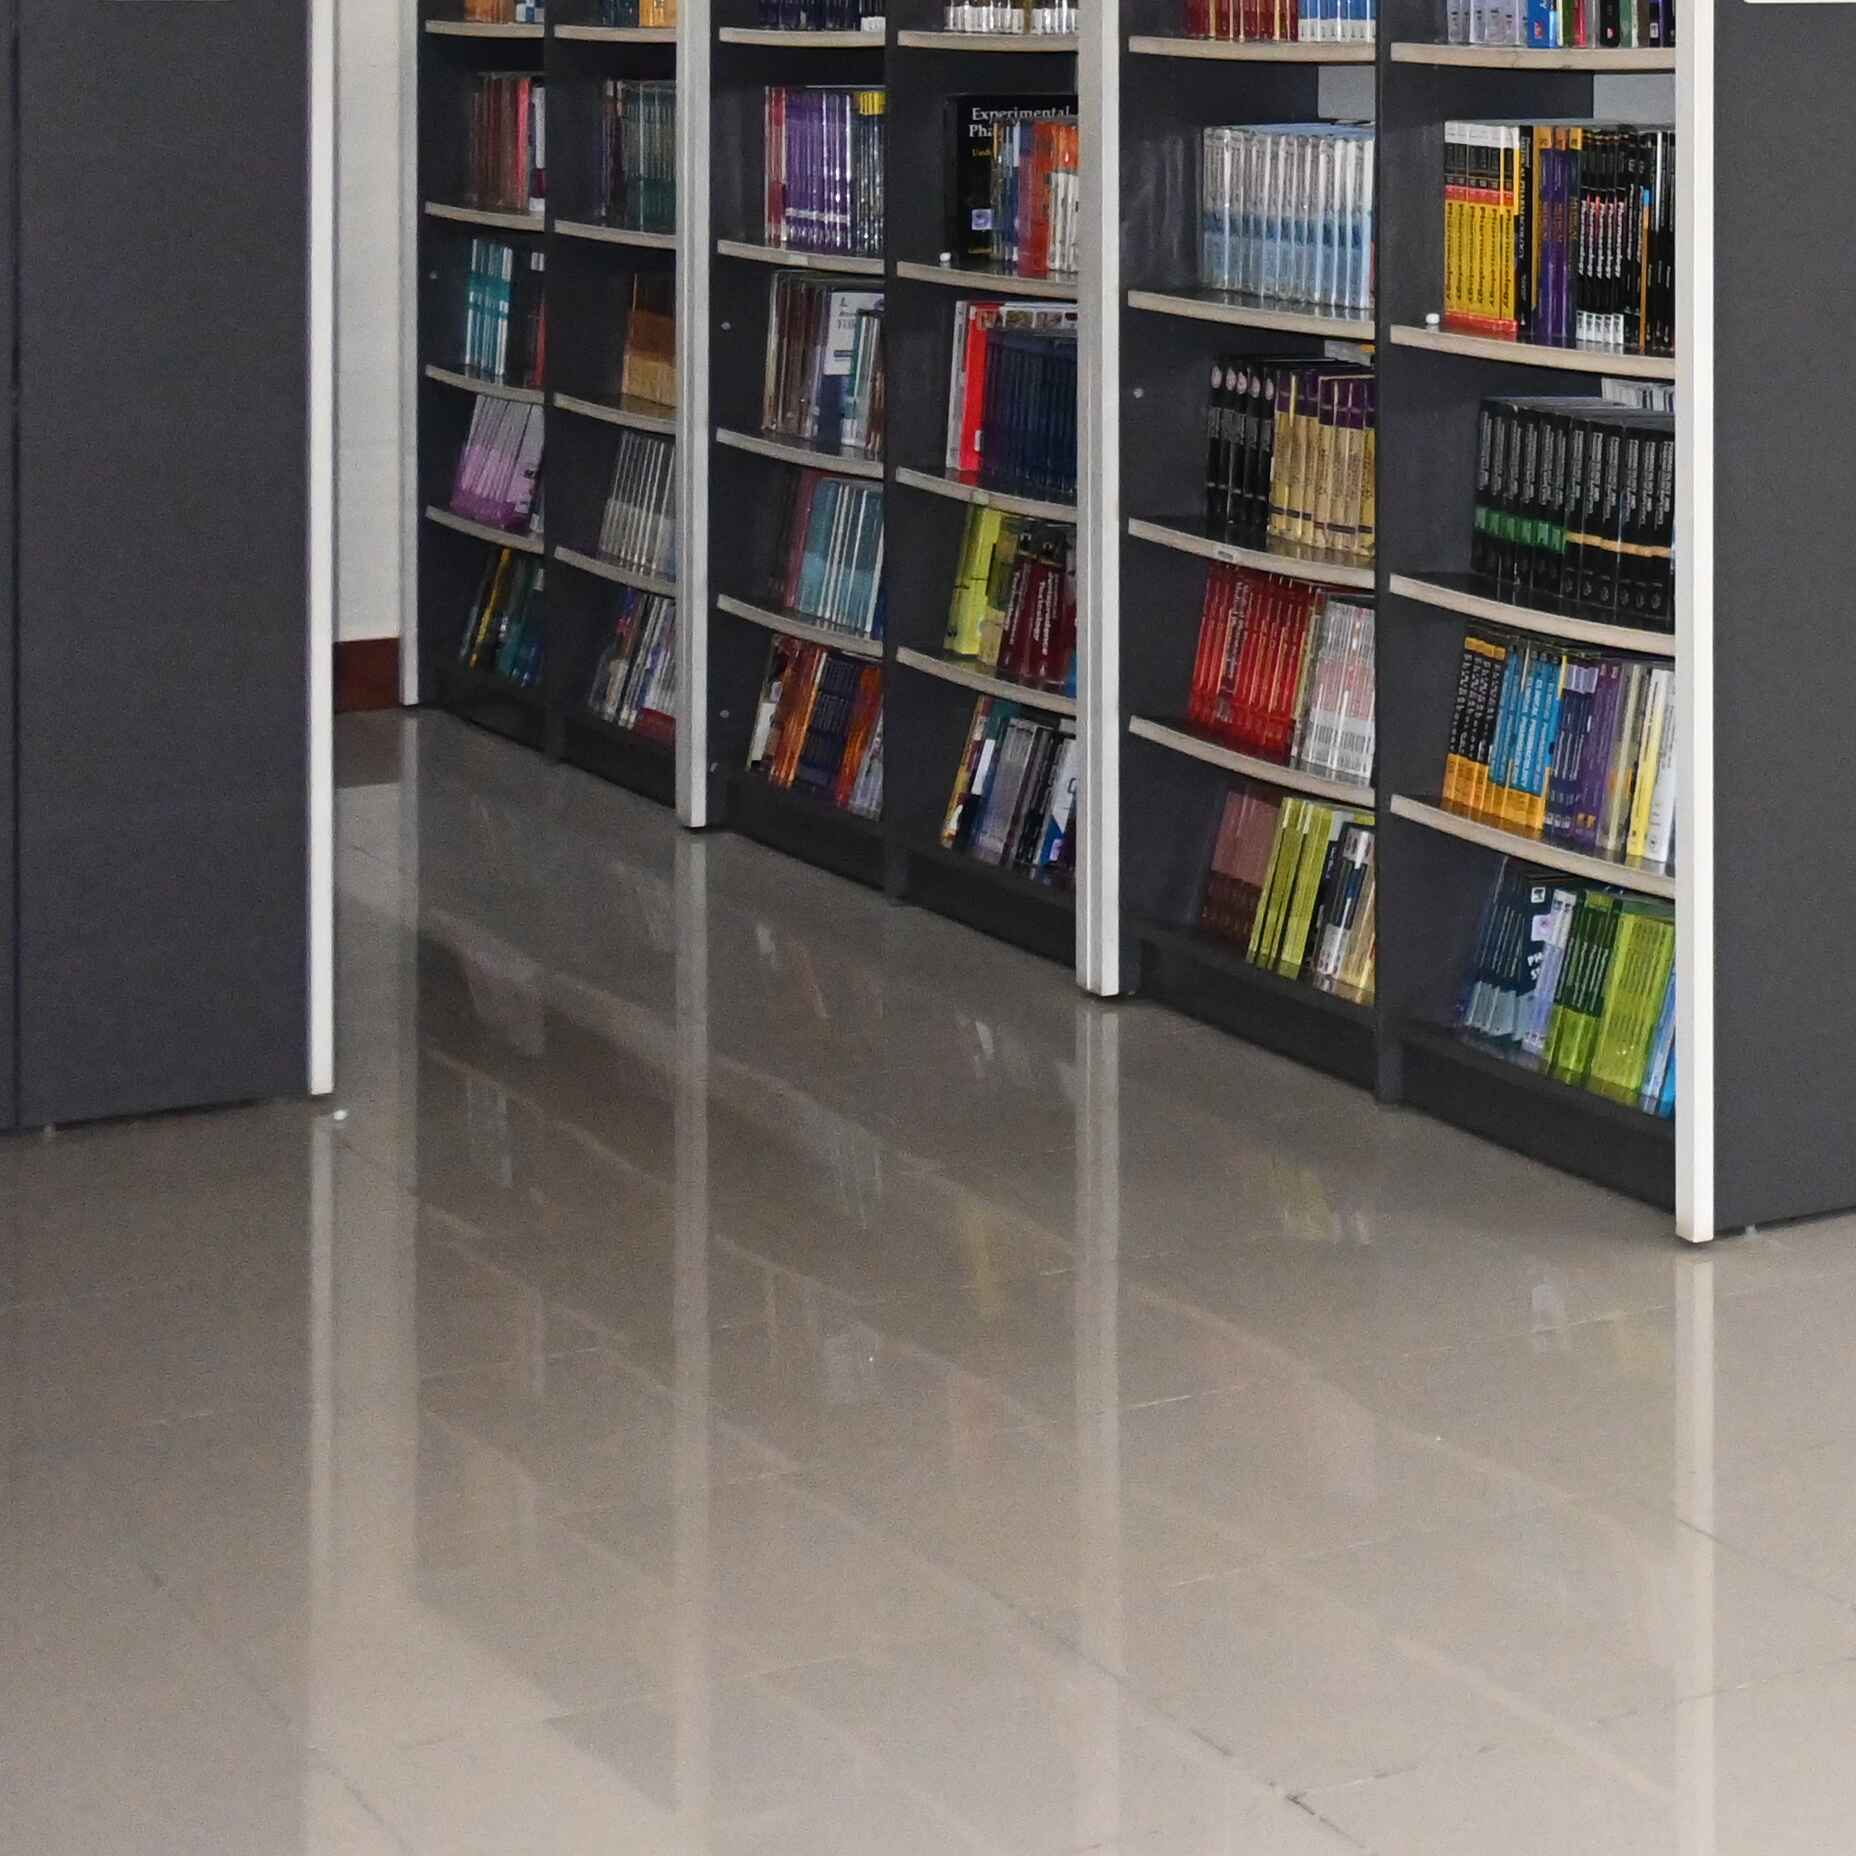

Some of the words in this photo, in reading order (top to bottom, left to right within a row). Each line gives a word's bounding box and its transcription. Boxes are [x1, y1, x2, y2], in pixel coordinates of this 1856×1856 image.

[972, 105, 1071, 124] Experimental
[1578, 200, 1587, 276] Pharmacology
[1587, 202, 1596, 278] Pharmacology
[1596, 203, 1605, 279] Pharmacology
[1605, 203, 1614, 279] Pharmacology
[1615, 201, 1624, 279] Pharmacology
